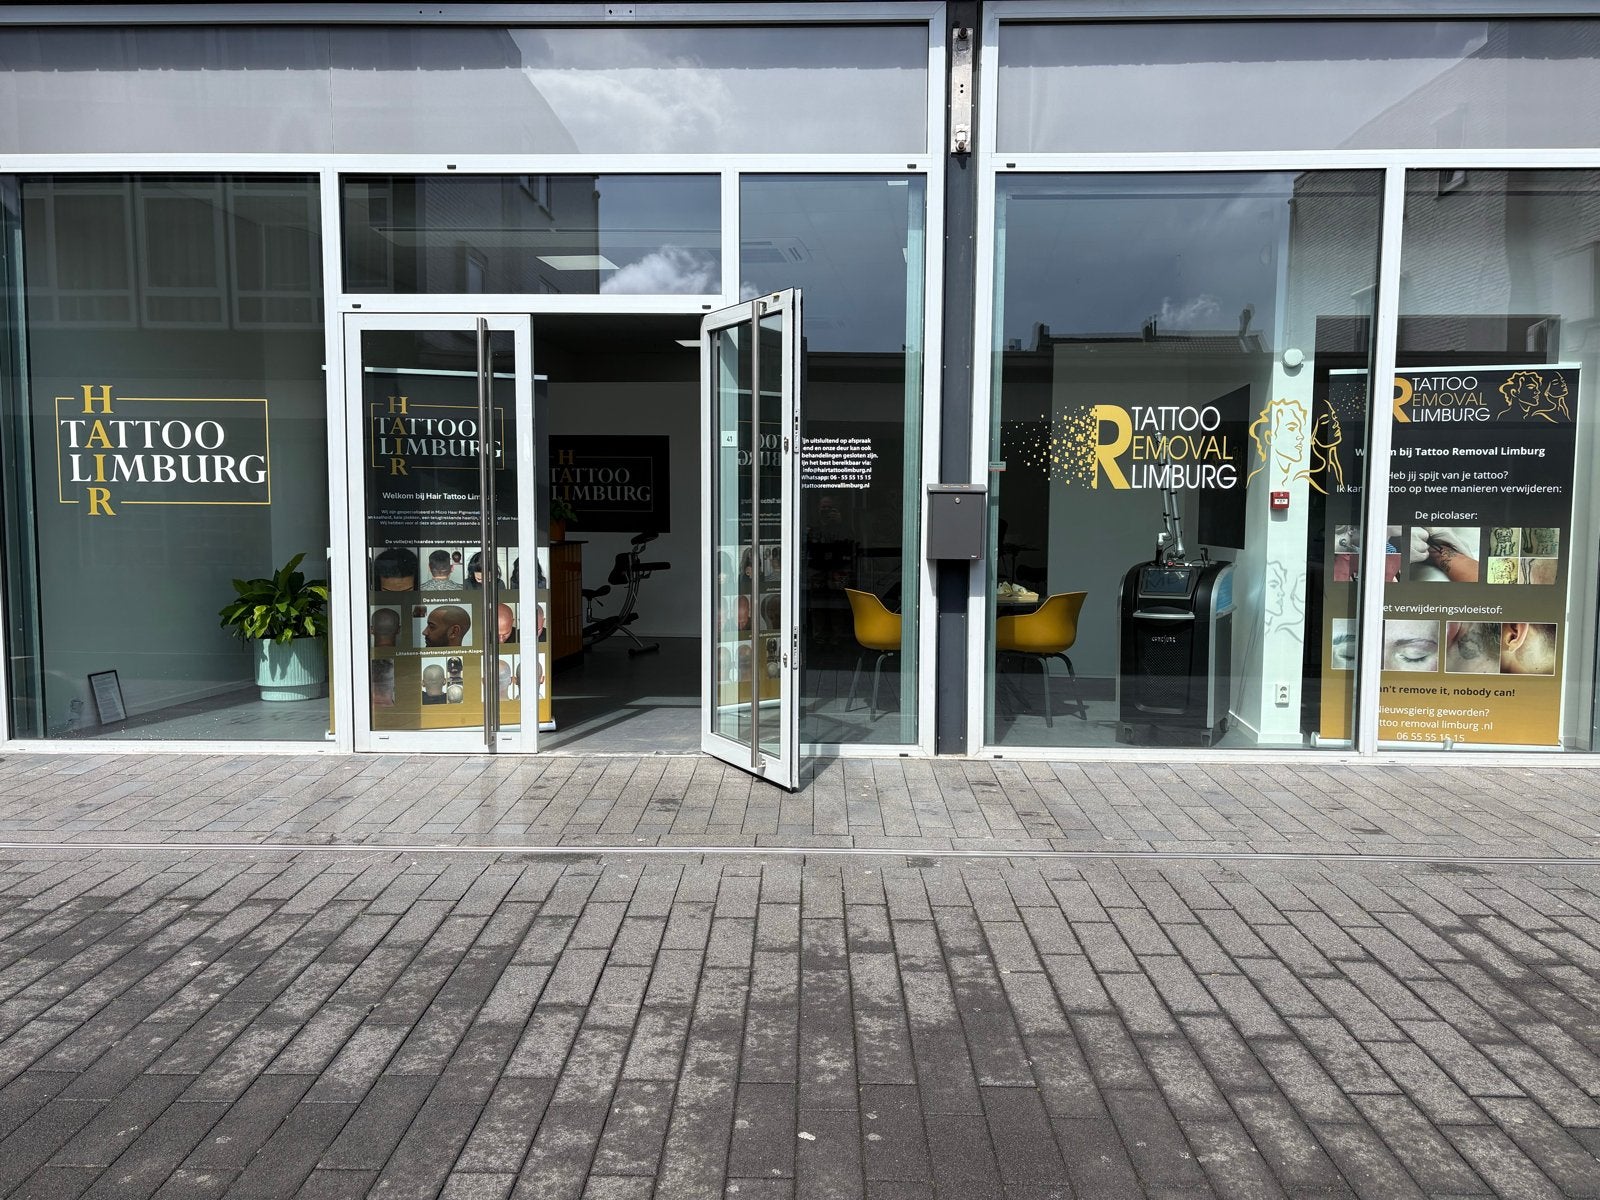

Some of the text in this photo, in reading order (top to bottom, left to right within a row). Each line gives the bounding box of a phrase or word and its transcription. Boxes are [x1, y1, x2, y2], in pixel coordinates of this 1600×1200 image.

[1412, 377, 1478, 391] TATTOO
[1132, 406, 1220, 431] TATTOO
[1413, 408, 1490, 422] LIMBURG
[374, 417, 476, 436] TATTOO
[60, 420, 225, 449] TATTOO
[1399, 448, 1412, 458] bij
[1415, 448, 1449, 456] Tattoo
[1452, 447, 1497, 456] Removal
[1501, 446, 1546, 458] Limburg
[69, 454, 267, 484] LIMBURG
[550, 467, 630, 483] TATTOO
[1132, 464, 1237, 489] LIMBURG
[1408, 471, 1417, 482] jij
[1419, 471, 1439, 482] spijt
[1462, 471, 1471, 482] je
[1473, 471, 1508, 480] tattoo?
[416, 492, 424, 500] bij
[1409, 486, 1422, 496] op
[1450, 484, 1498, 493] manieren
[1501, 484, 1562, 495] verwijderen:
[1415, 511, 1478, 522] De picolaser:
[1395, 604, 1502, 615] verwijderingsvloeistof:
[1440, 686, 1450, 696] it,
[1453, 687, 1491, 698] nobody
[1494, 688, 1515, 697] can!
[1437, 707, 1489, 718] geworden?
[1379, 720, 1493, 731] ttoo removal limburg .nl
[1396, 732, 1408, 740] 06
[1411, 732, 1422, 741] 55
[1425, 733, 1436, 741] 55
[1454, 734, 1465, 742] 15
